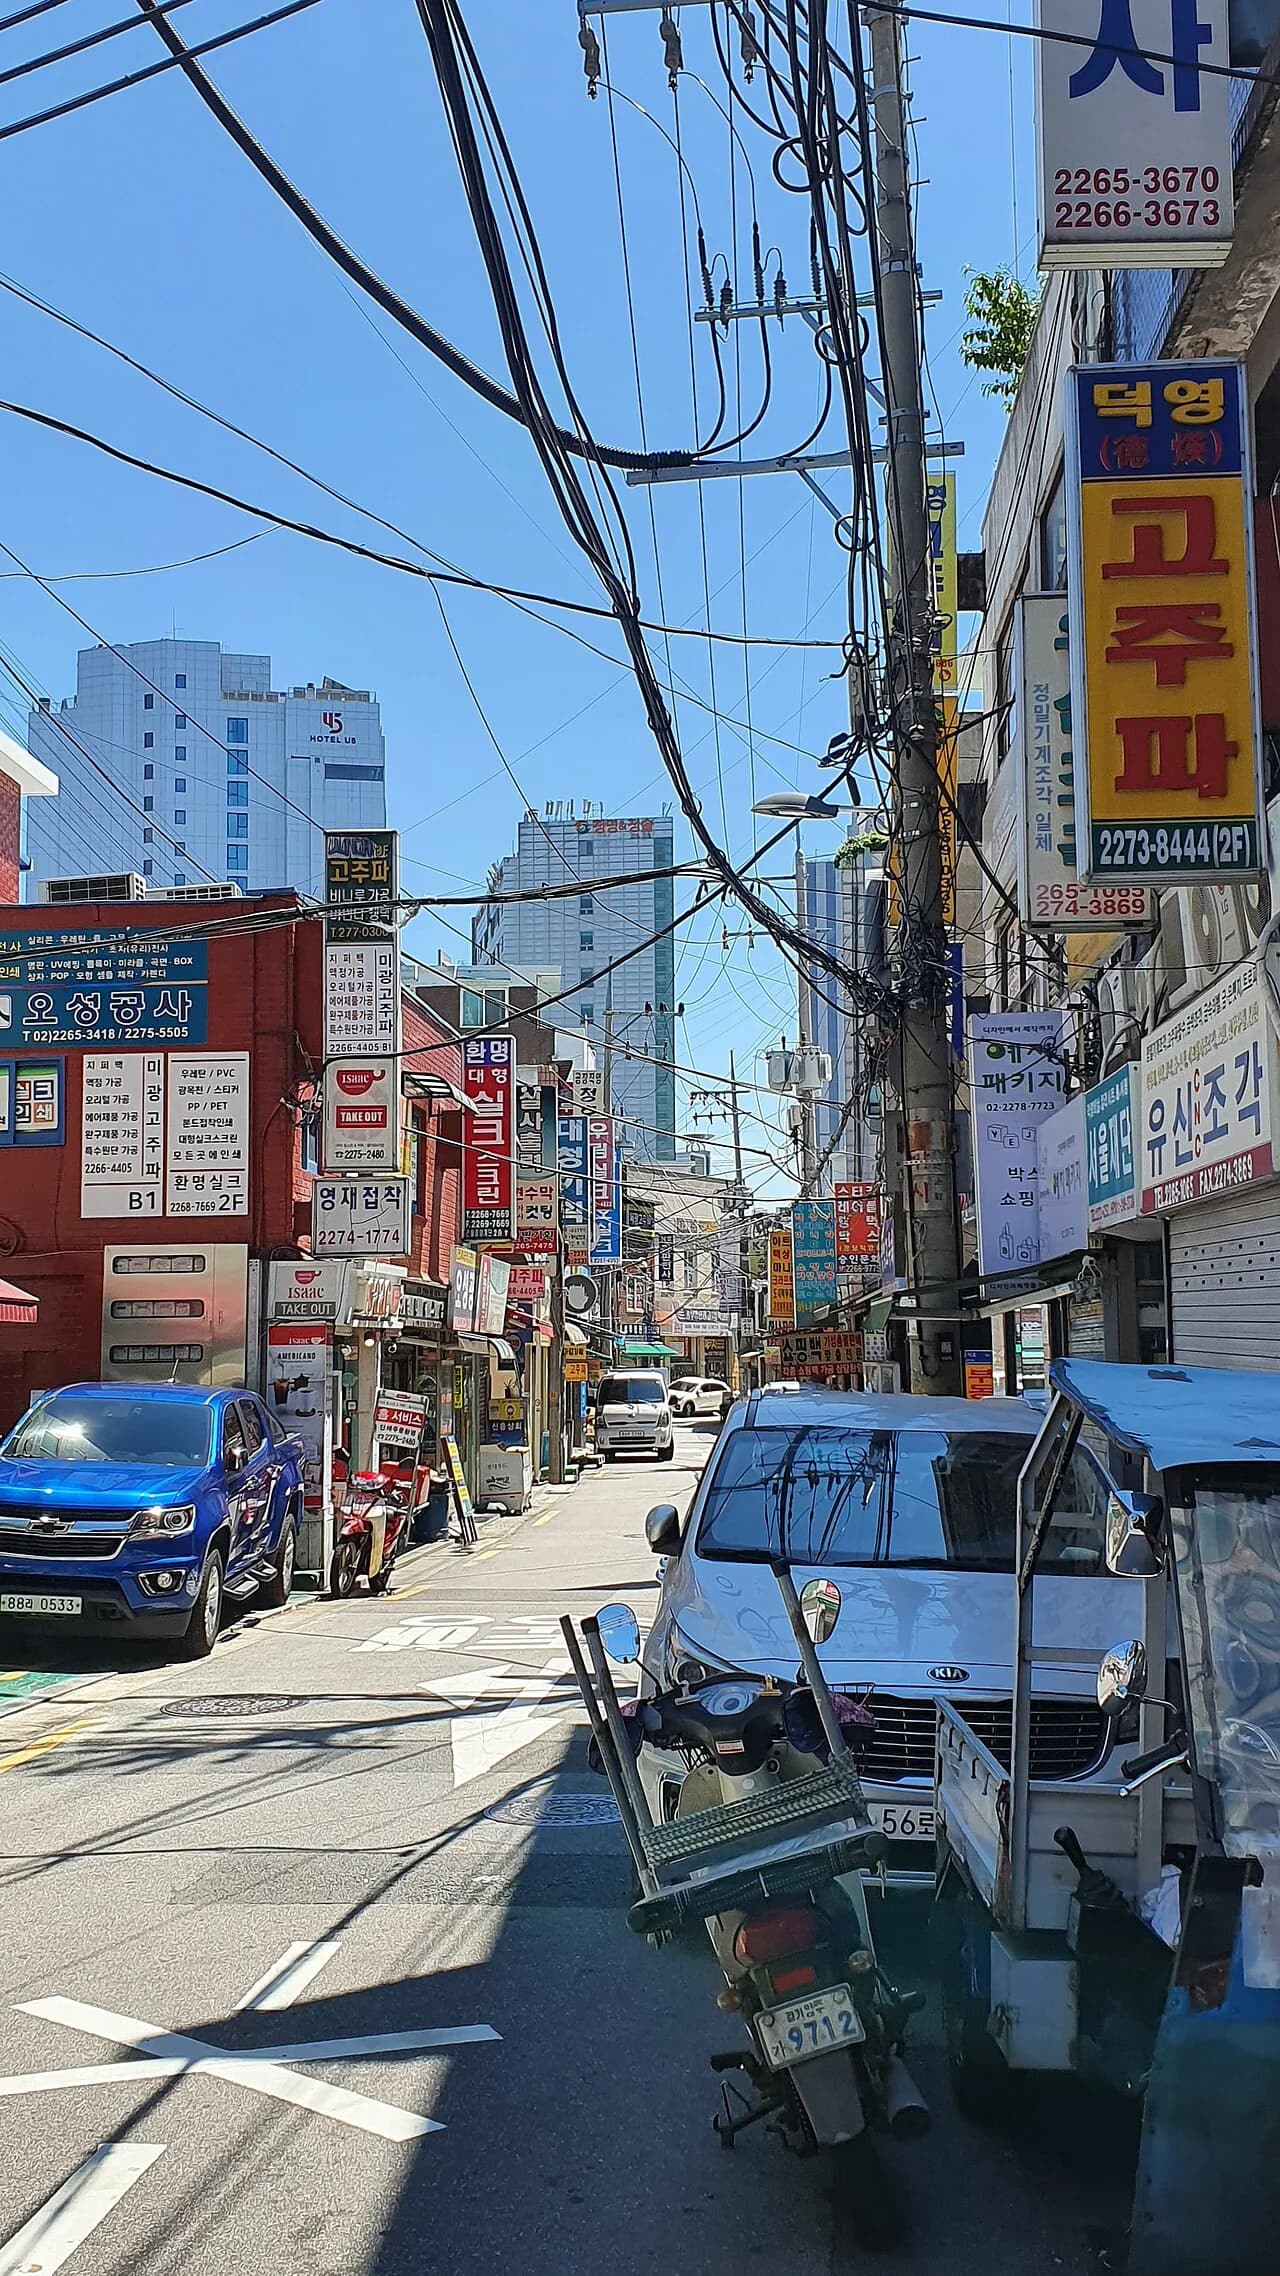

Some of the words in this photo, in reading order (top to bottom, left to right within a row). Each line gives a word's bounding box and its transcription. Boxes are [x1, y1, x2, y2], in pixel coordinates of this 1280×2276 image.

[1055, 167, 1219, 194] 2265-3670
[1055, 201, 1219, 228] 2266-3673
[1093, 379, 1224, 428] 덕영
[1102, 495, 1238, 799] 고주파
[310, 735, 341, 744] HOTEL
[1100, 824, 1251, 869] 2273-8444(2F)
[329, 860, 389, 884] 고주파
[1036, 899, 1146, 916] 274-3869
[173, 956, 193, 965] BOX
[50, 971, 69, 980] POP
[379, 953, 394, 1034] 미광고주파
[22, 989, 192, 1027] 오성공사
[33, 1030, 115, 1043] 02)2265-3418
[125, 1027, 188, 1039] 2275-5505
[330, 1044, 379, 1052] 2266-4405
[466, 1041, 509, 1065] 환명
[216, 1069, 236, 1078] PVC
[468, 1067, 508, 1084] 대형
[213, 1084, 240, 1095] 스티커
[982, 1071, 1061, 1094] 패키지
[188, 1102, 200, 1111] PP
[210, 1102, 228, 1111] PET
[145, 1059, 162, 1179] 미광고주파
[340, 1111, 363, 1122] TAKE
[365, 1111, 383, 1122] OUT
[344, 1150, 385, 1160] 2275-2480
[1088, 1106, 1132, 1189] 서울재단
[85, 1163, 132, 1174] 2266-4405
[173, 1174, 242, 1191] 환명실크
[129, 1191, 156, 1210] B1
[170, 1201, 216, 1212] 2268-7669
[218, 1193, 244, 1211] 2F
[319, 1185, 401, 1211] 영재접착
[1000, 1191, 1034, 1207] 쇼핑
[318, 1229, 400, 1246] 2274-1774
[281, 1303, 307, 1315] TAKE
[311, 1303, 332, 1315] OUT
[277, 1352, 316, 1360] AMERICANO
[391, 1410, 422, 1425] 서비스
[40, 1598, 74, 1611] 0533
[934, 1668, 965, 1680] KIA
[787, 2010, 857, 2053] 9712
